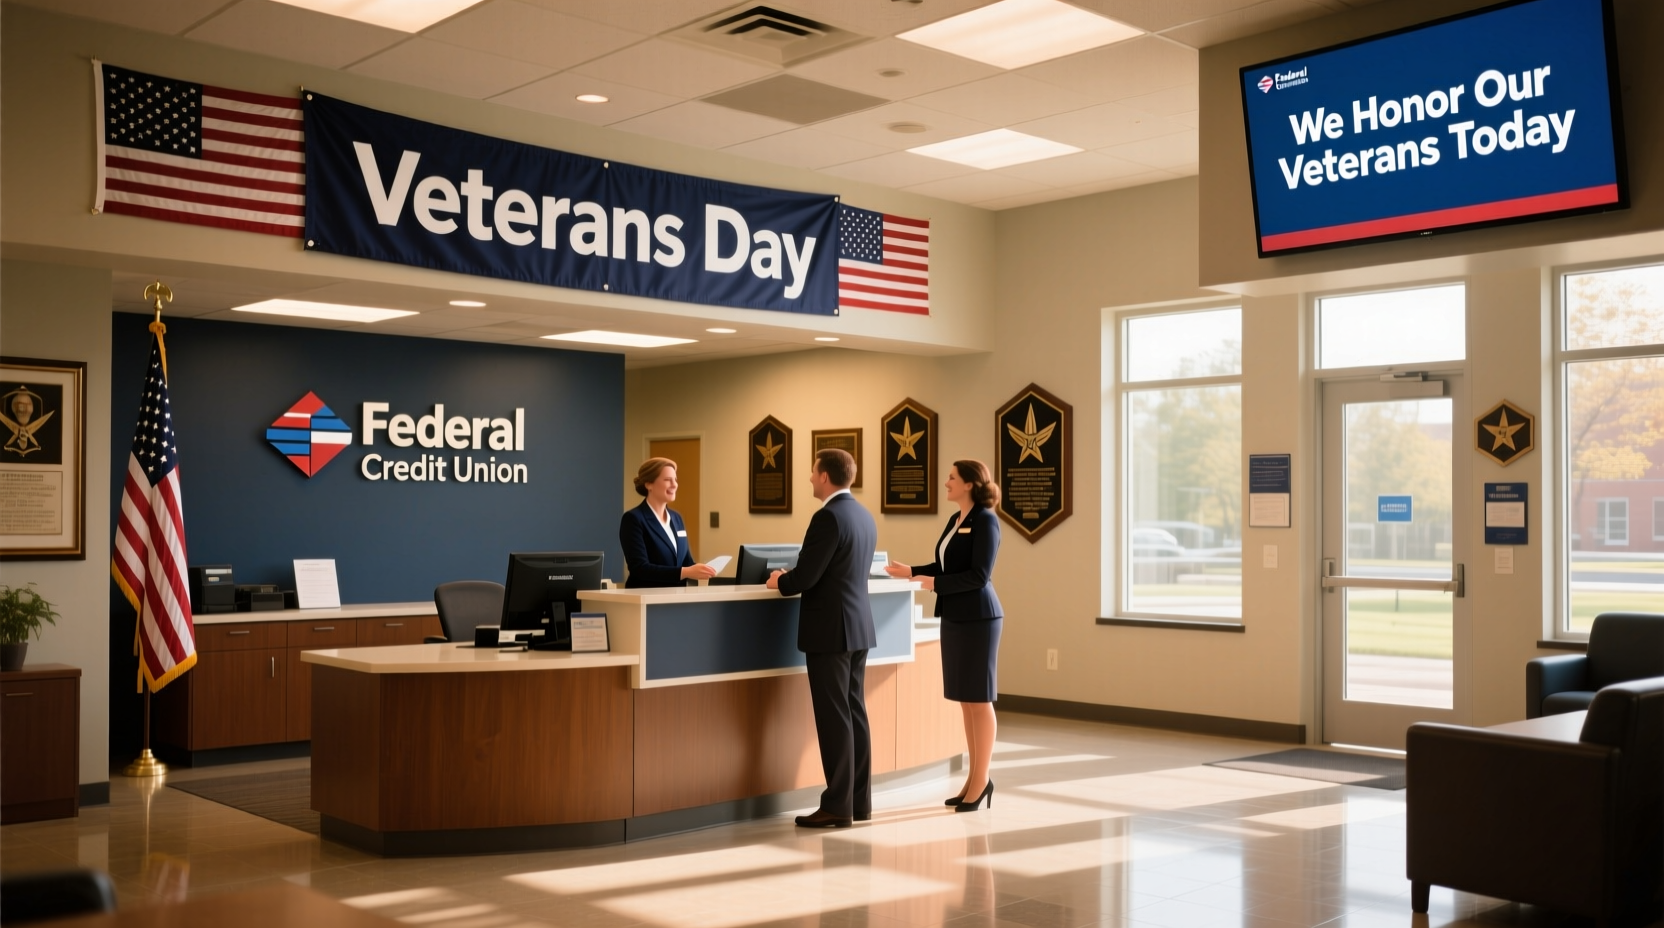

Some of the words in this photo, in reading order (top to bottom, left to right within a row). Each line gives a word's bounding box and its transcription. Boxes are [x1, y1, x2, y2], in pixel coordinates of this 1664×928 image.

[1289, 107, 1343, 145] We
[1353, 84, 1464, 134] Honor
[1475, 65, 1551, 107] Our
[1278, 137, 1440, 190] Veterans
[1448, 109, 1576, 159] Today
[353, 142, 685, 268] Veterans
[705, 204, 816, 300] Day
[362, 402, 525, 451] Federal
[361, 453, 447, 482] Credit
[454, 456, 528, 484] Union
